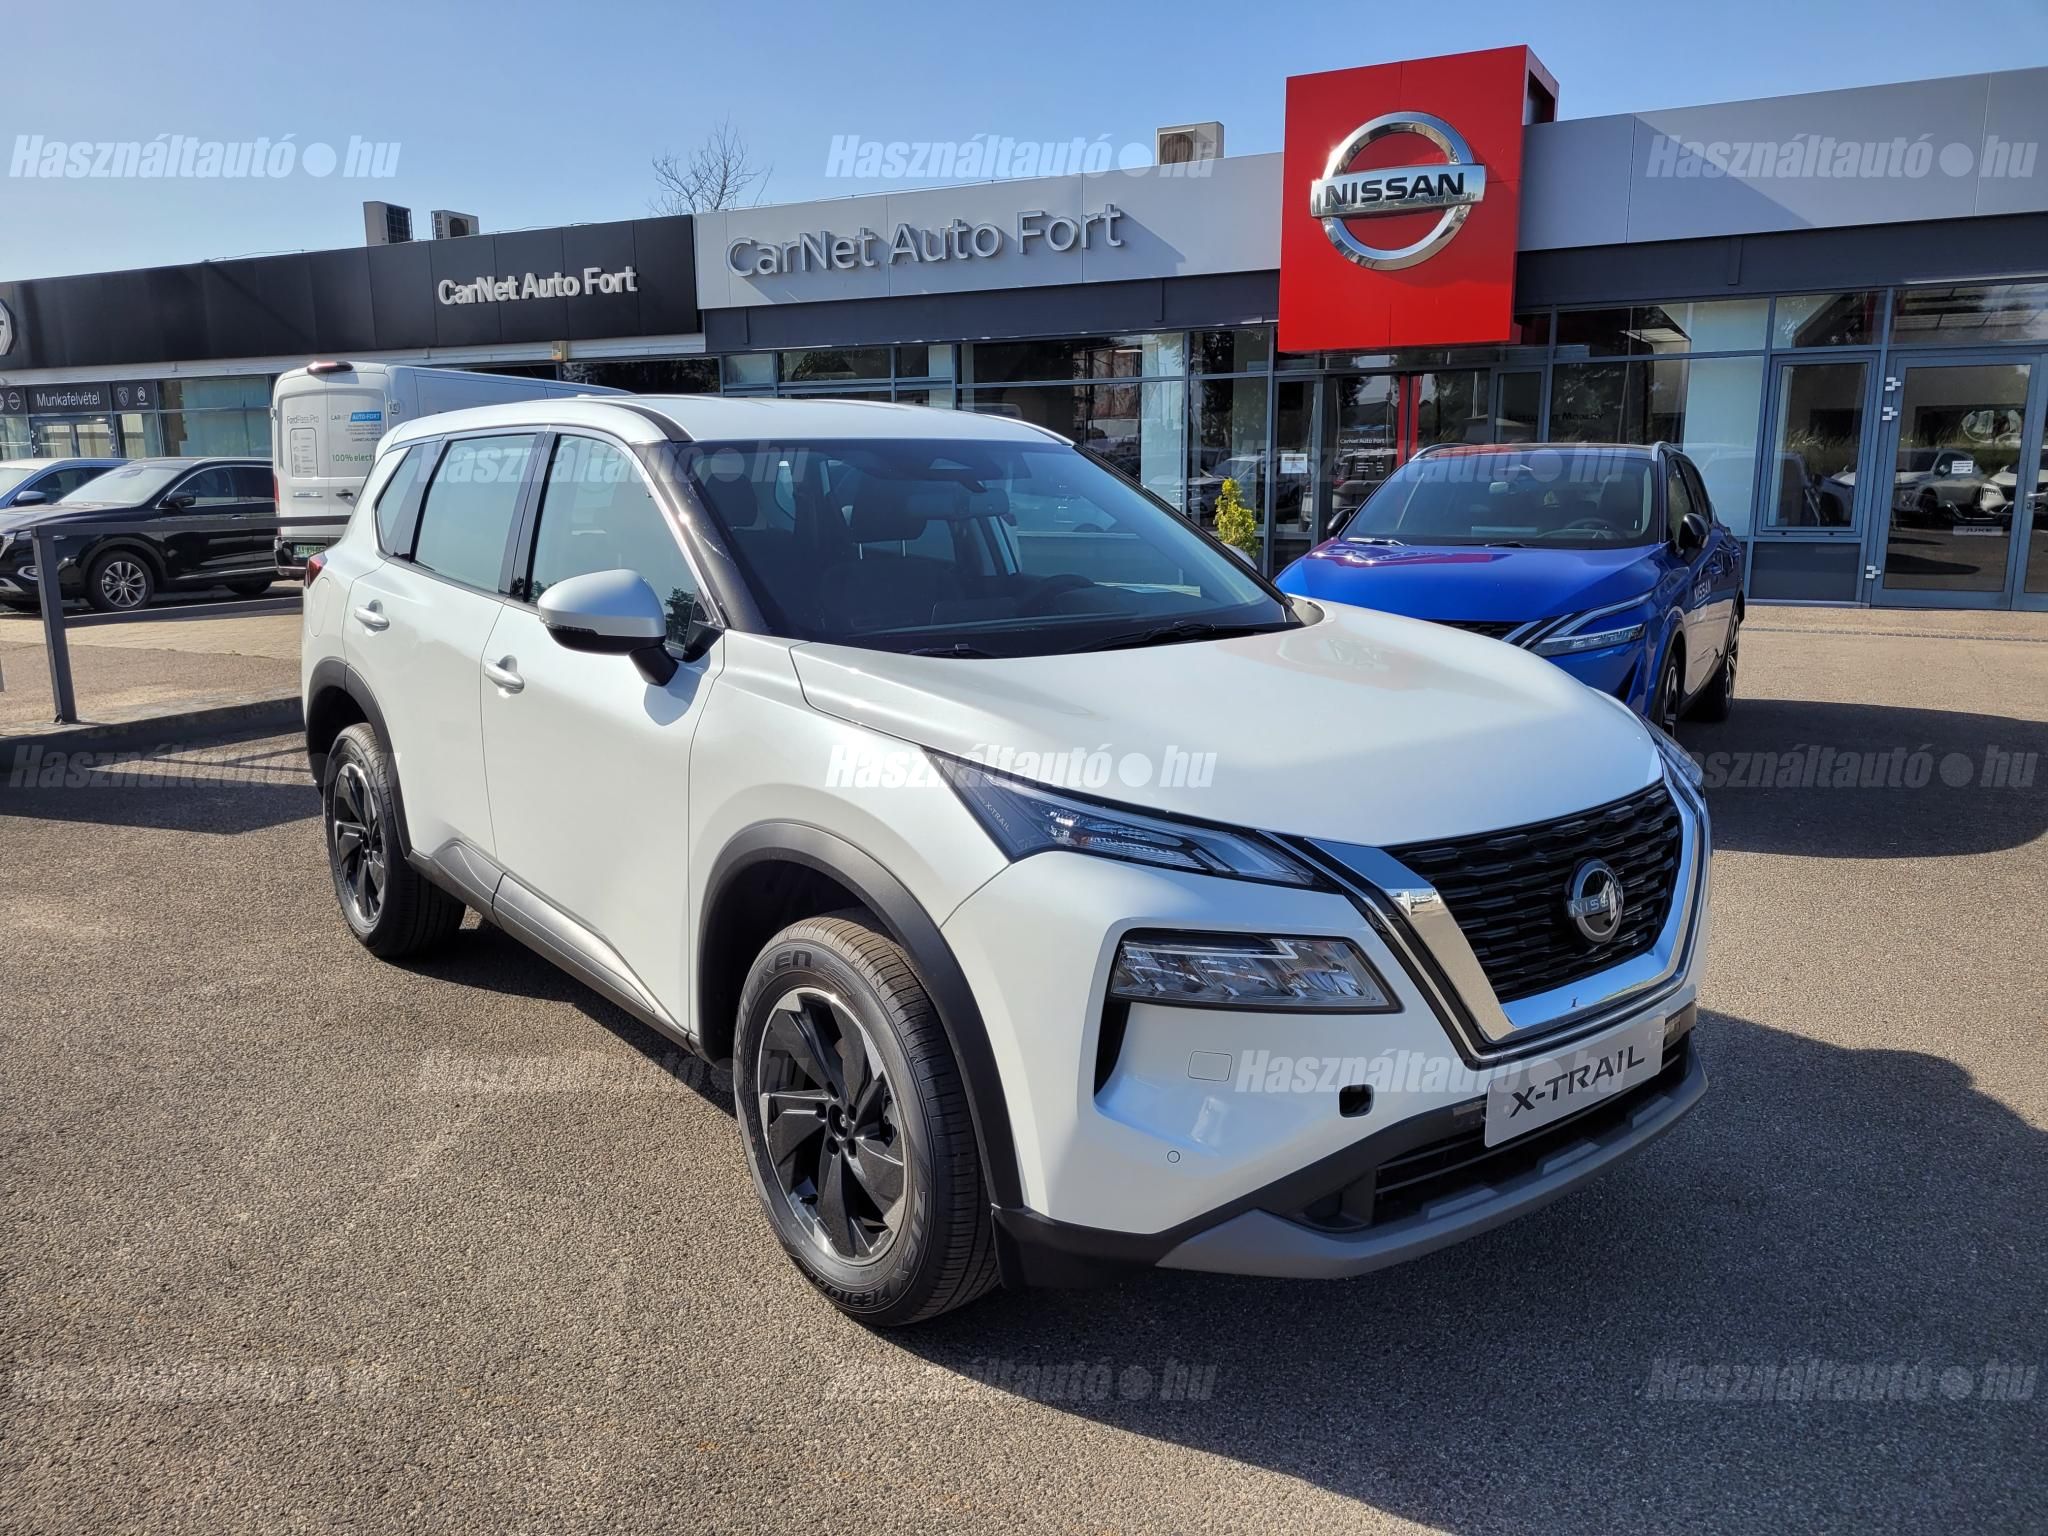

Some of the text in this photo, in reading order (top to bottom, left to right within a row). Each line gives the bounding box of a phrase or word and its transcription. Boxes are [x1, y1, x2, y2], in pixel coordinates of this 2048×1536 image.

[1325, 172, 1465, 208] NISSAN
[725, 203, 1125, 278] CarNet Auto Fort
[438, 265, 638, 305] CarNet Auto Fort
[36, 391, 101, 408] Munkafelvétel
[354, 453, 376, 463] elect
[984, 800, 1010, 832] X-TRAIL
[1570, 897, 1618, 918] NISS
[1509, 1044, 1645, 1119] X-TRAIL
